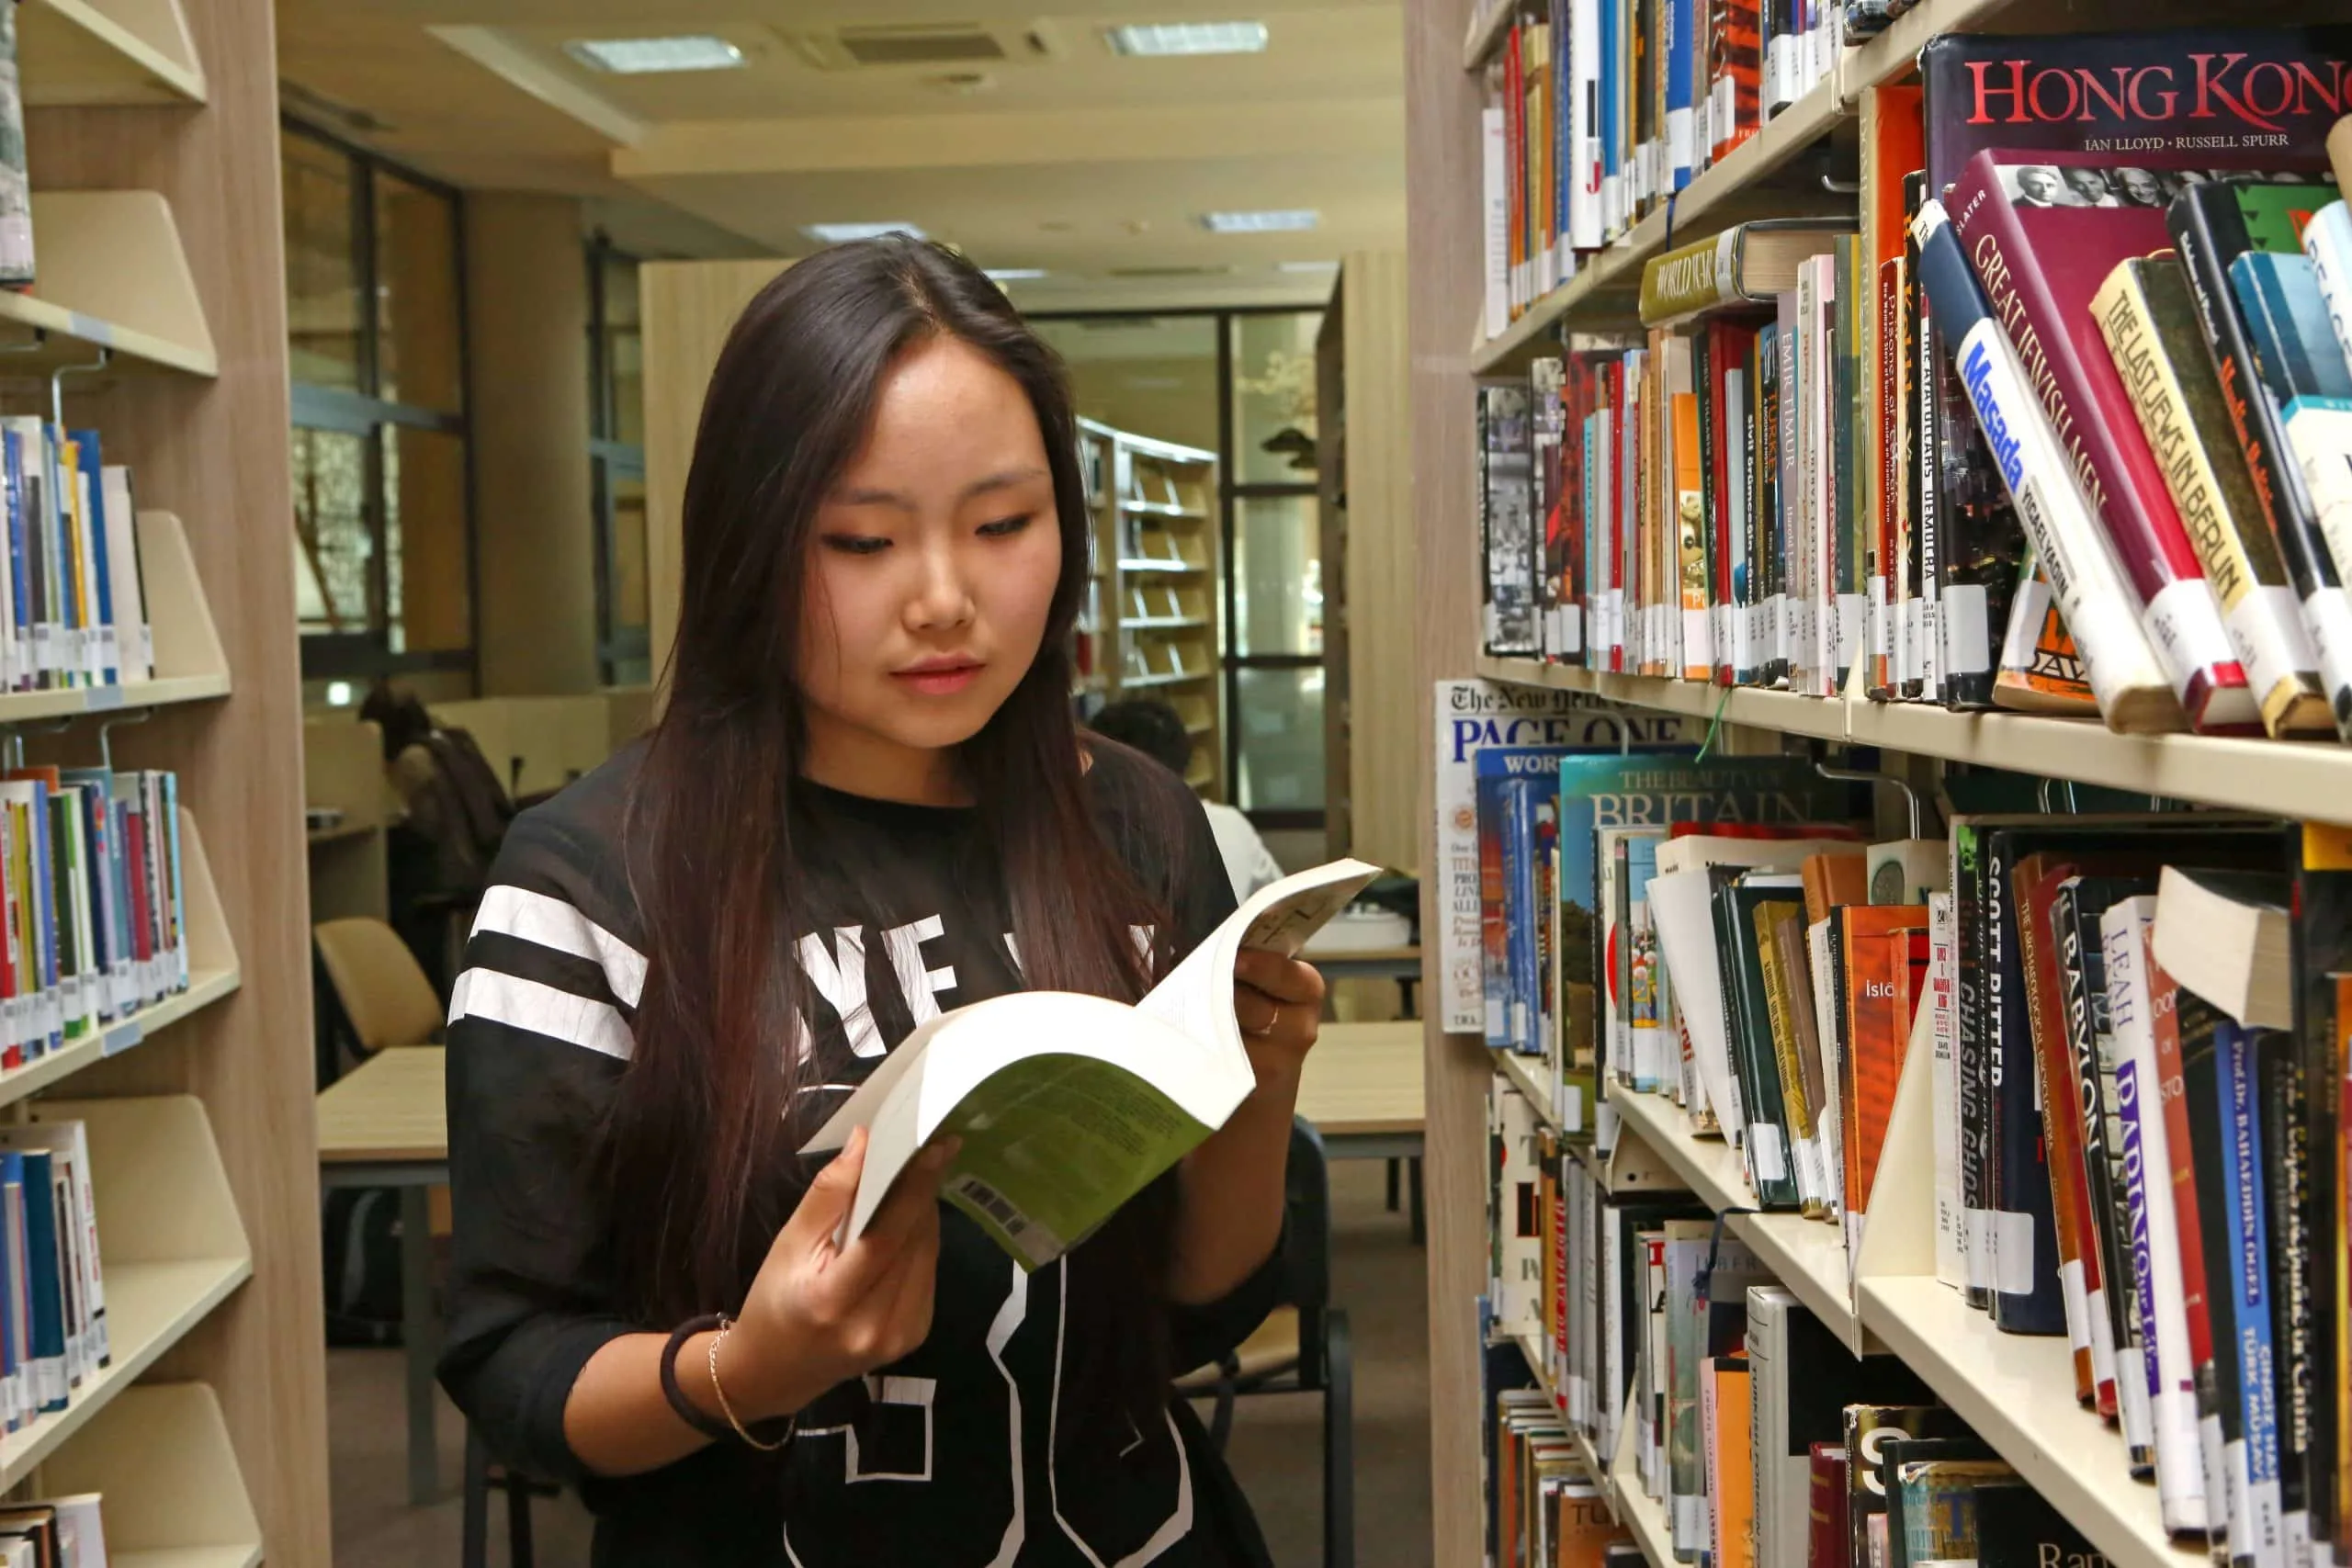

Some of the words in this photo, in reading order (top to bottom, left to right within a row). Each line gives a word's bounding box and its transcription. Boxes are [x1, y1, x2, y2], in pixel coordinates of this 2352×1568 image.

[1963, 59, 2179, 126] HONG
[2188, 52, 2352, 131] KON
[2085, 140, 2110, 152] IAN
[2116, 137, 2165, 151] LLOYD
[2176, 135, 2238, 149] RUSSELL
[2242, 133, 2290, 148] SPURR
[1955, 189, 1987, 237] SLATER
[1975, 234, 2028, 333] GREAT
[2016, 322, 2074, 445] JEWISH
[2069, 434, 2108, 510] MEN
[1964, 339, 2024, 494] Masada
[2109, 288, 2138, 345] THE
[2125, 332, 2161, 402] LAST
[2144, 388, 2186, 458] JEWS
[2171, 450, 2199, 494] IN
[2185, 487, 2243, 601] BERLIN
[1924, 491, 1935, 581] DEMOCRA
[1451, 685, 1493, 715] The
[1495, 687, 1546, 711] New
[1503, 755, 1559, 773] WOR
[1618, 771, 1667, 789] THE
[1589, 792, 1815, 827] BRITAIN
[2109, 927, 2134, 1030] LEAH
[1961, 982, 1977, 1118] CHASING
[2061, 931, 2101, 1153] BABYLON
[1962, 1126, 1978, 1209] GHOS
